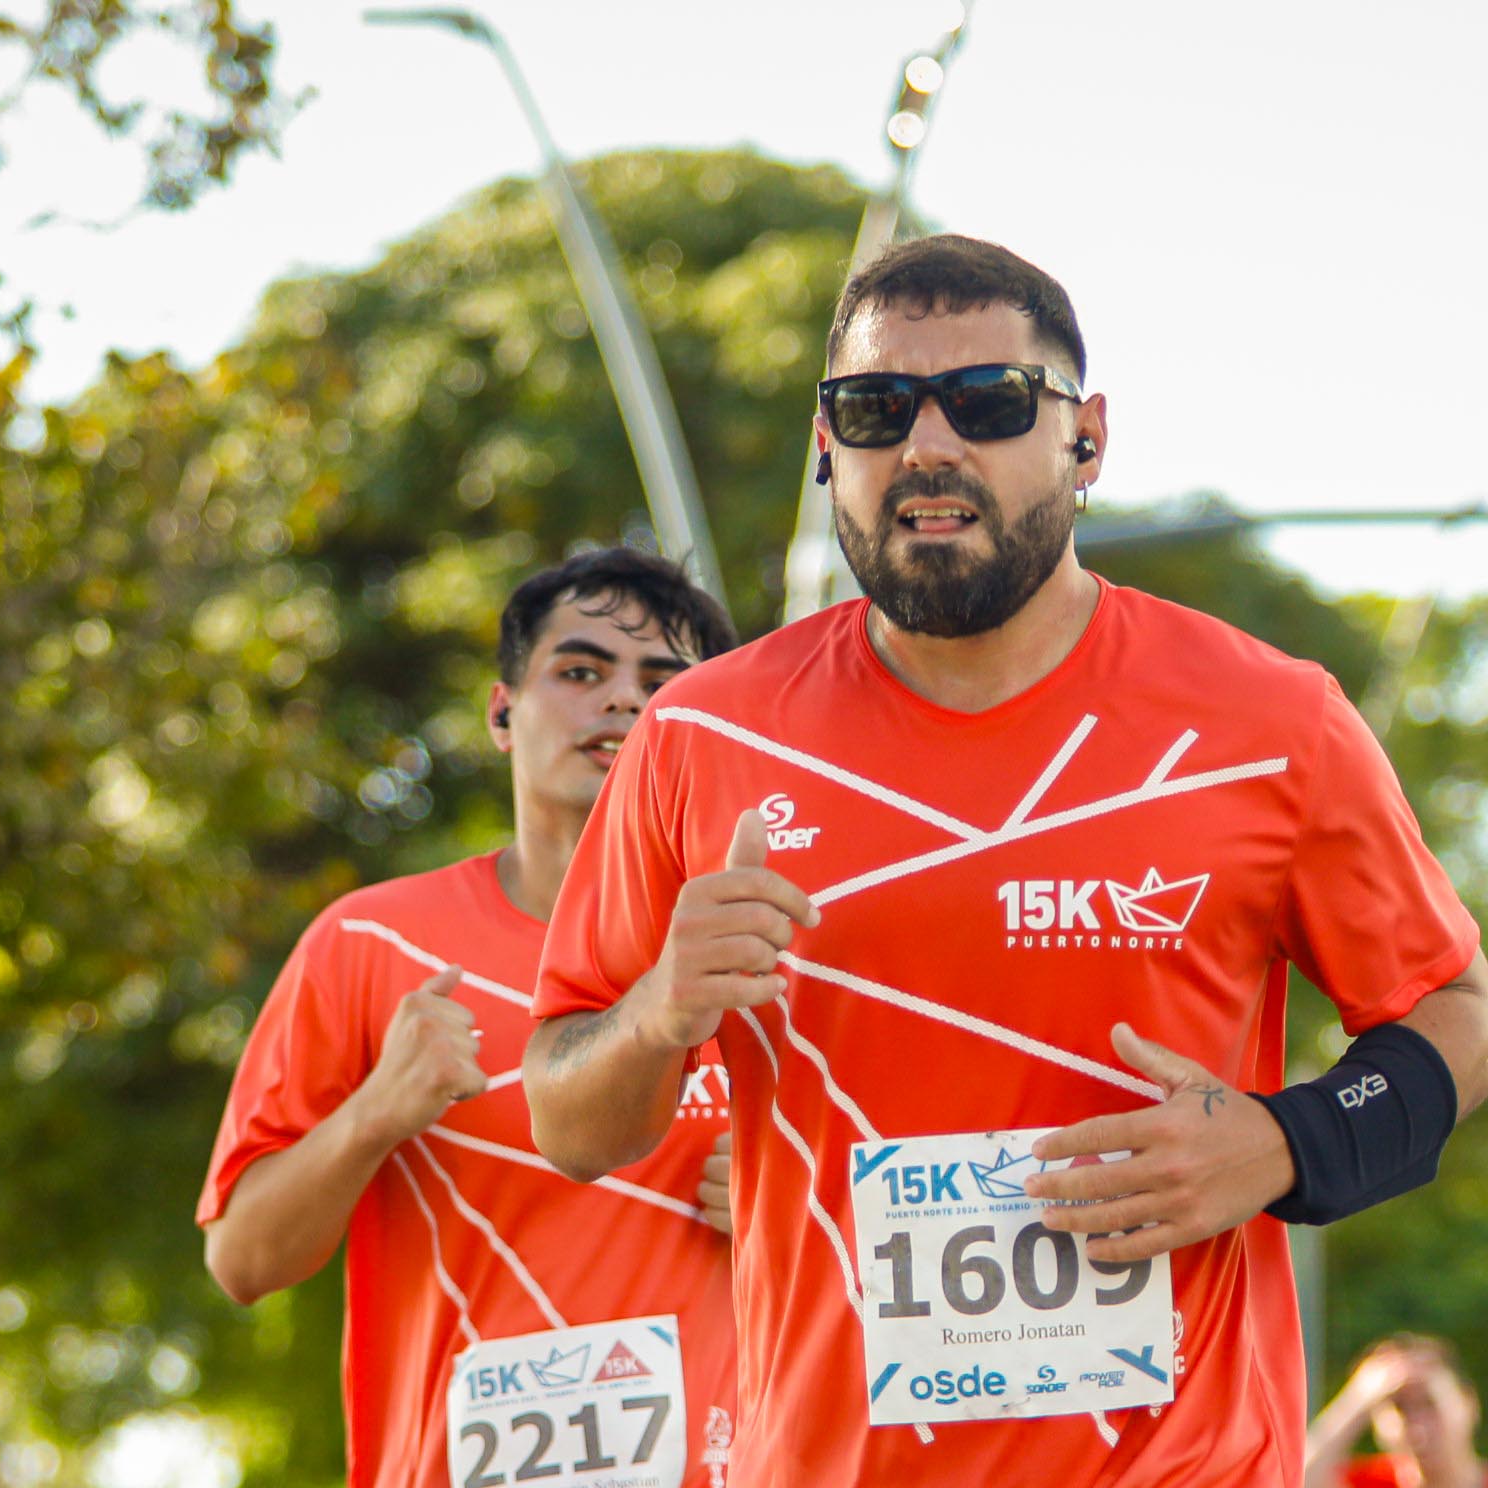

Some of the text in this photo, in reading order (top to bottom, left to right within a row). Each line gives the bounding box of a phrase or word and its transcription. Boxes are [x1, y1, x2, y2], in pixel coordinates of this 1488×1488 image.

[767, 827, 821, 850] Der
[998, 880, 1101, 930] 15K
[1007, 935, 1183, 949] PUERTO NORTE
[1337, 1073, 1388, 1108] DX3
[881, 1163, 962, 1205] 15K
[885, 1210, 921, 1219] PUERTO
[923, 1207, 953, 1216] NORTE
[989, 1202, 1031, 1212] ROSARIO
[874, 1221, 1153, 1318] 1609
[942, 1321, 1086, 1345] Romero Jonatan
[468, 1364, 522, 1400] 15K
[909, 1364, 1006, 1405] osde
